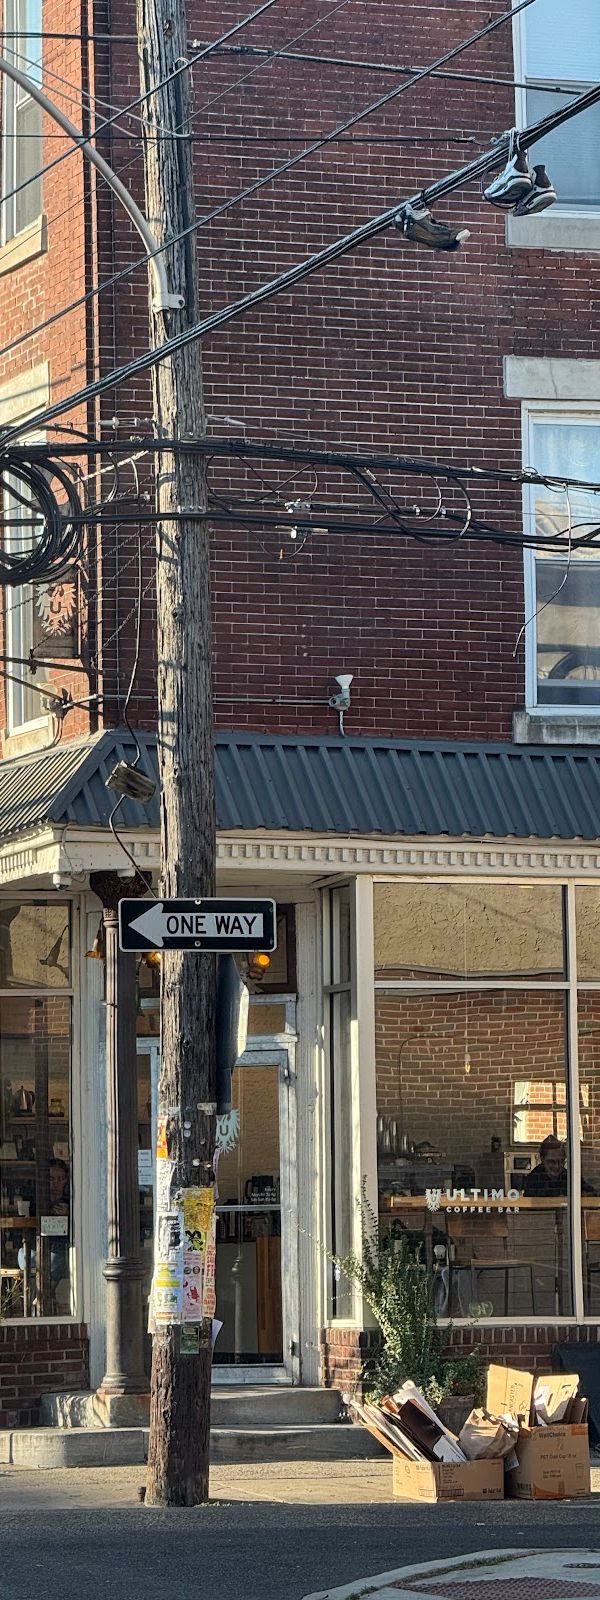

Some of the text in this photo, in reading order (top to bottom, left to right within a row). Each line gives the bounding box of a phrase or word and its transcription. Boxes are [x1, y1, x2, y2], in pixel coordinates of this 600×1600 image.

[166, 915, 257, 935] ONE WAY
[446, 1188, 520, 1202] ULTIMO
